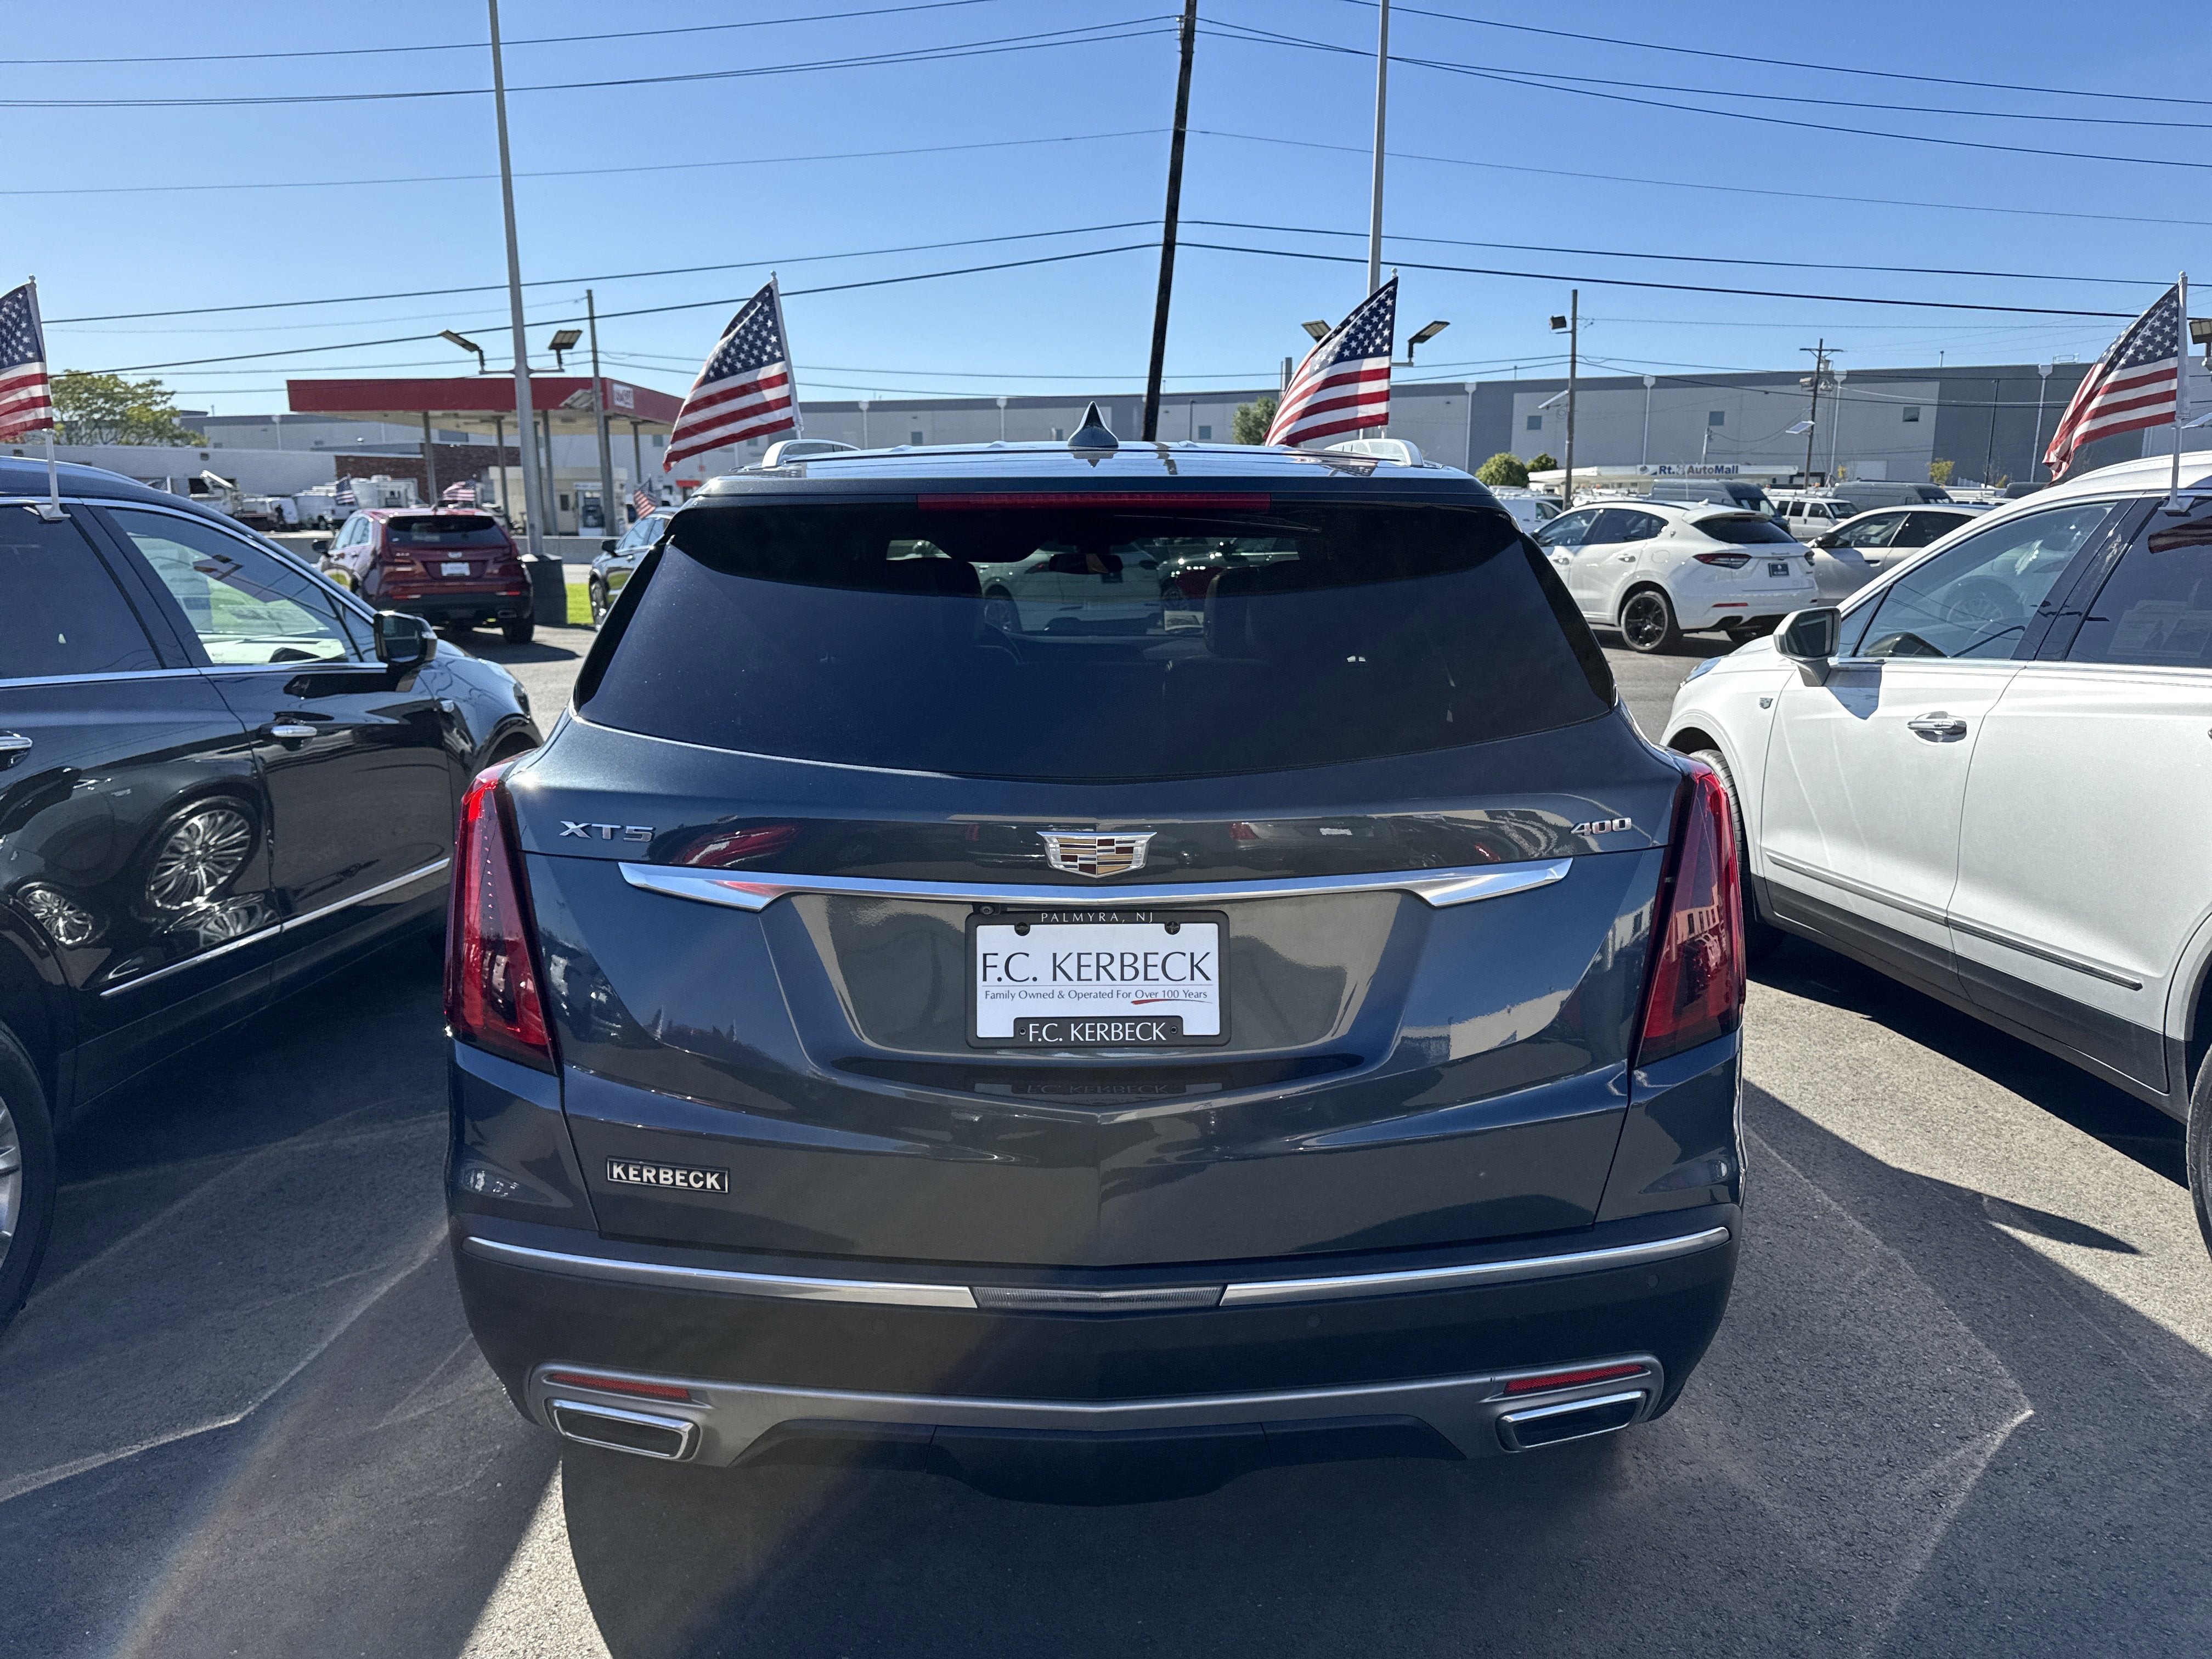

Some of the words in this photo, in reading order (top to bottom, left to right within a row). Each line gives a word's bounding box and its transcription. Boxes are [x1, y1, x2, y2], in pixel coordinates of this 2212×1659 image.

[1659, 465, 1675, 475] Rt.
[1687, 465, 1739, 475] AutoMall
[559, 821, 656, 842] XT5
[1571, 817, 1632, 836] 400
[1041, 912, 1125, 923] PALMYRA,
[1136, 912, 1153, 923] NJ
[982, 952, 1037, 983] F.C.
[1052, 951, 1212, 982] KERBECK
[985, 990, 1016, 1001] Family
[1018, 989, 1054, 999] Owned
[1057, 990, 1065, 999] &
[1068, 989, 1114, 1001] Operated
[1116, 990, 1132, 999] For
[1135, 989, 1159, 998] Over
[1161, 989, 1180, 998] 100
[1183, 989, 1207, 998] Years
[1029, 1023, 1063, 1042] F.C.
[1070, 1022, 1166, 1041] KERBECK
[612, 1162, 721, 1190] KERBECK
